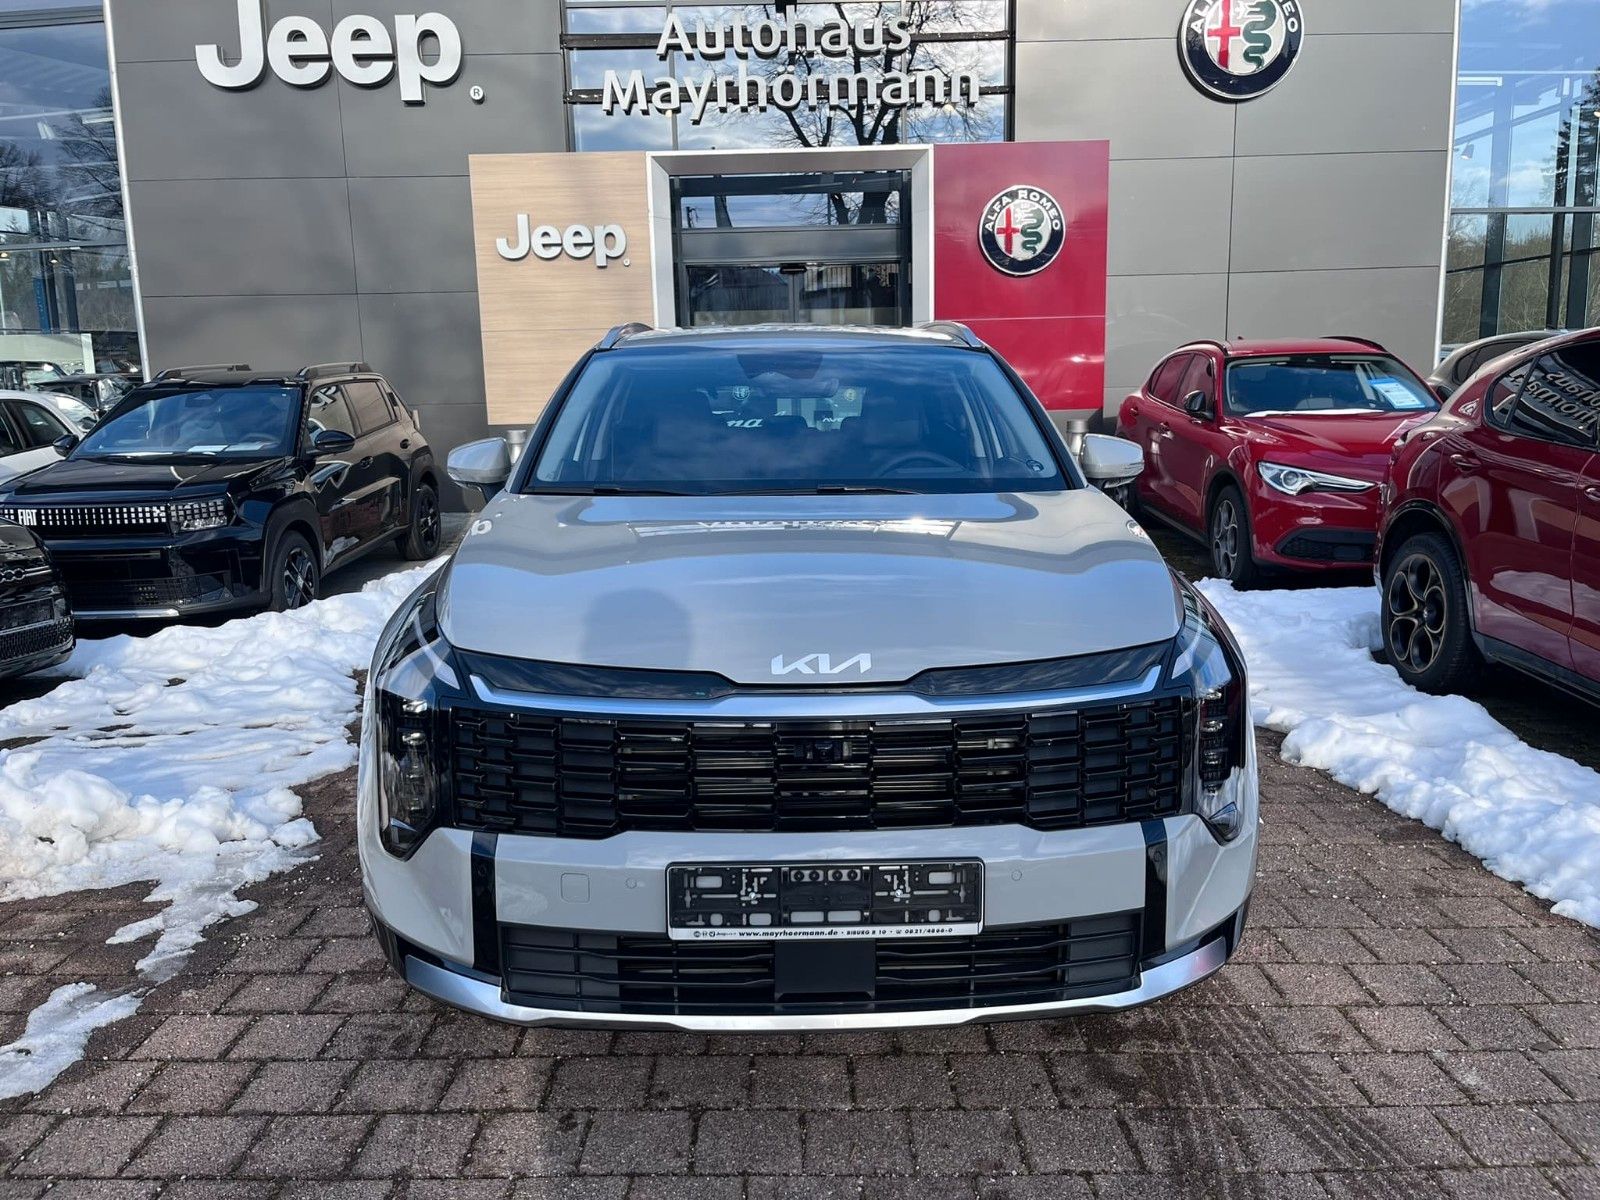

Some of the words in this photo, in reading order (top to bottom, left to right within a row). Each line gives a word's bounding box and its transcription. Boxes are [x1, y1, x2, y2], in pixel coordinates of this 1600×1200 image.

[195, 0, 462, 104] Jeep
[656, 5, 911, 60] Autohaus
[602, 60, 980, 124] Mayrhörmann
[985, 195, 1012, 232] ALFA
[1018, 190, 1061, 230] ROMEO
[496, 213, 627, 268] Jeep
[17, 509, 37, 526] FIAT
[771, 653, 872, 675] KIA
[739, 929, 838, 938] www.mayrhoermann.de
